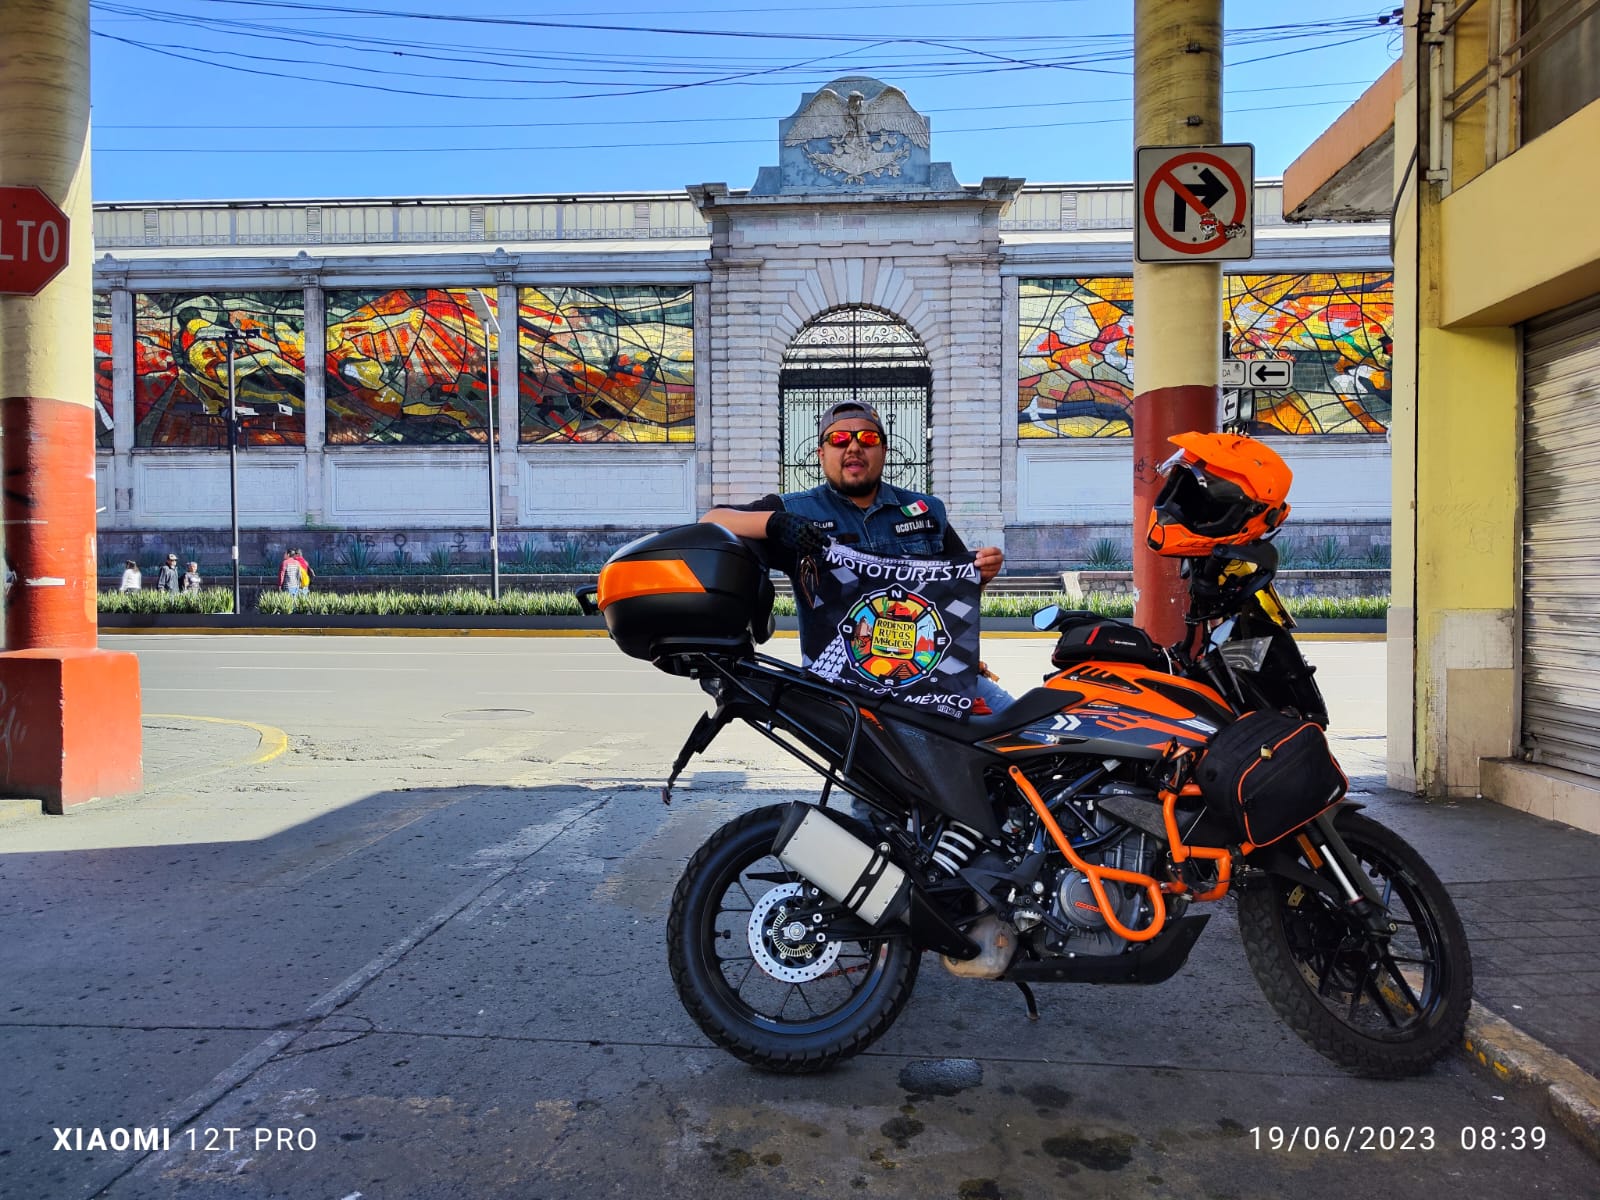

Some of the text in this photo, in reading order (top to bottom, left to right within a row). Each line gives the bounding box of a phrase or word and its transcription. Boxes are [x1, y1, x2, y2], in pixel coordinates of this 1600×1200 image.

[826, 550, 976, 582] MOTOTURISTA
[891, 590, 902, 598] N
[937, 636, 946, 645] E
